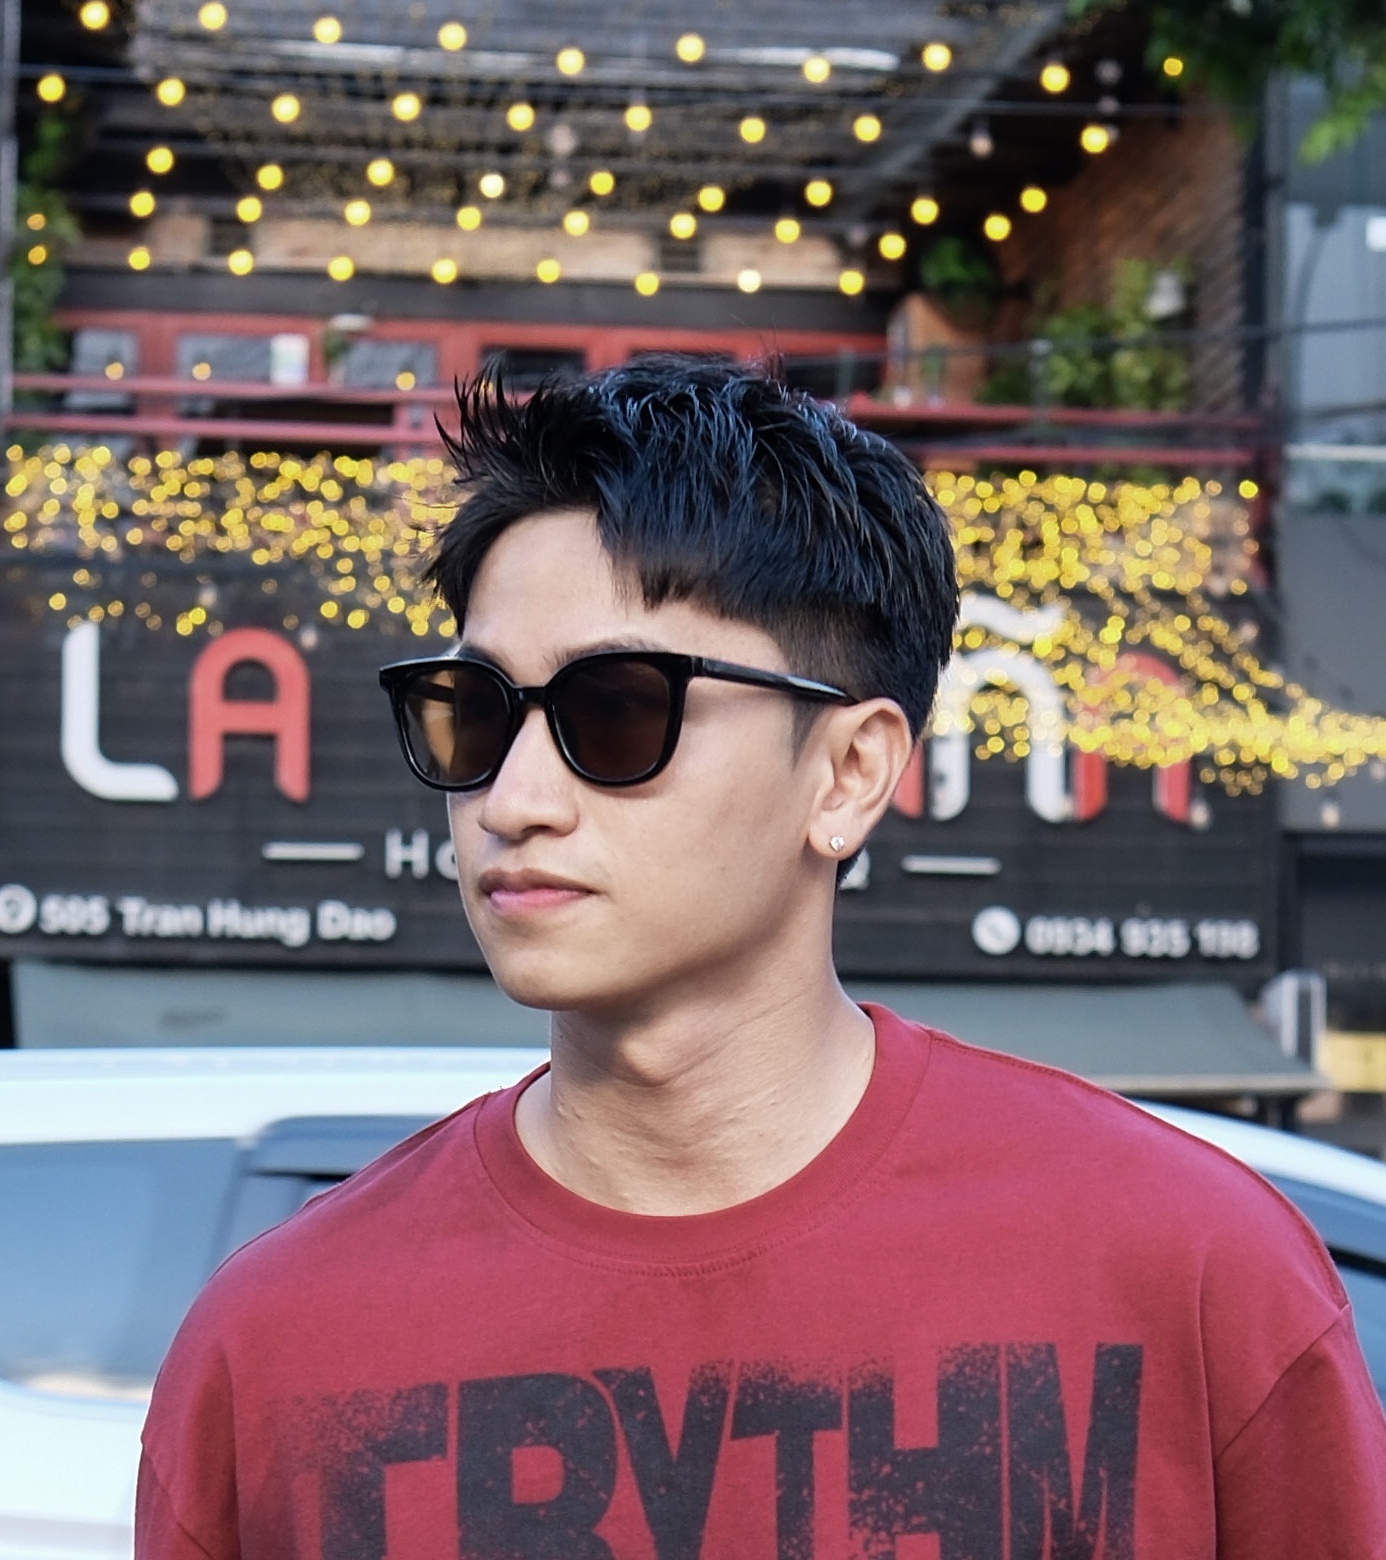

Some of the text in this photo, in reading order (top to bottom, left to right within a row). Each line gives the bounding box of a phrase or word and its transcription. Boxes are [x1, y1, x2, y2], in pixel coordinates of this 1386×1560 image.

[61, 620, 311, 804] LA
[115, 895, 204, 938] Tran
[207, 898, 312, 948] Hung
[317, 900, 397, 942] Dao
